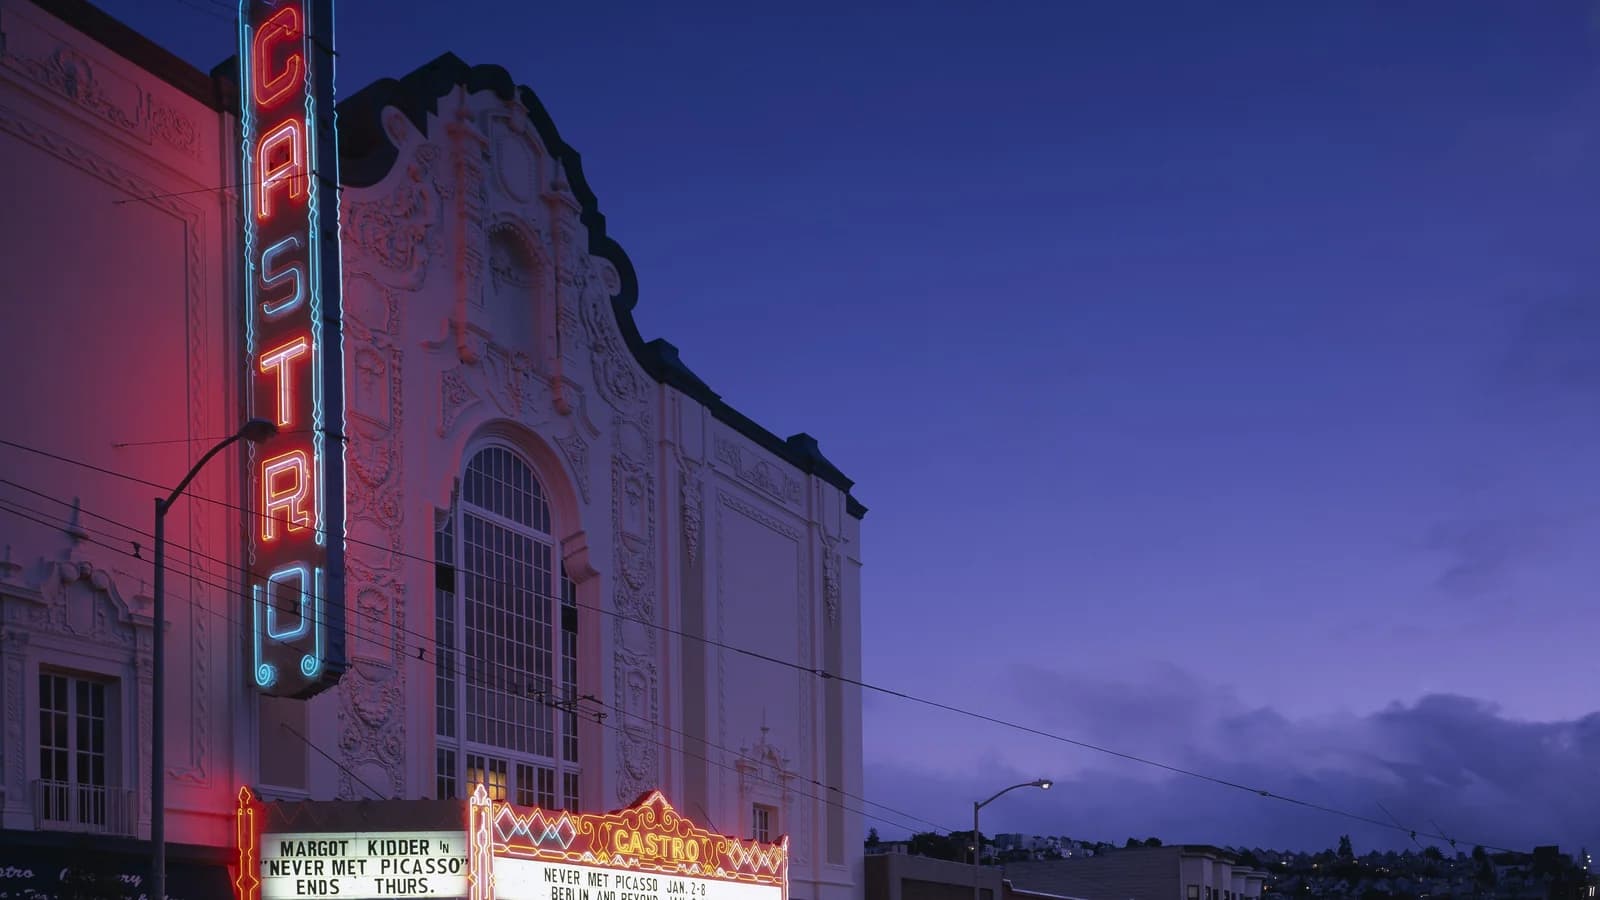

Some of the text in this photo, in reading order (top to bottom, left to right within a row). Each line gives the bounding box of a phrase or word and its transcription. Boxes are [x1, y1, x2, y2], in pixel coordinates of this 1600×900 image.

[254, 7, 310, 640] CASTRO
[280, 840, 348, 857] MARGOT
[367, 839, 430, 856] KIDDER
[615, 829, 700, 862] CASTRO
[332, 859, 367, 875] MET
[296, 877, 435, 895] ENDS THURS.
[544, 867, 706, 896] NEVER MET PICASSO JAN. 2-8
[551, 886, 589, 900] BERLIN
[597, 890, 616, 900] AND
